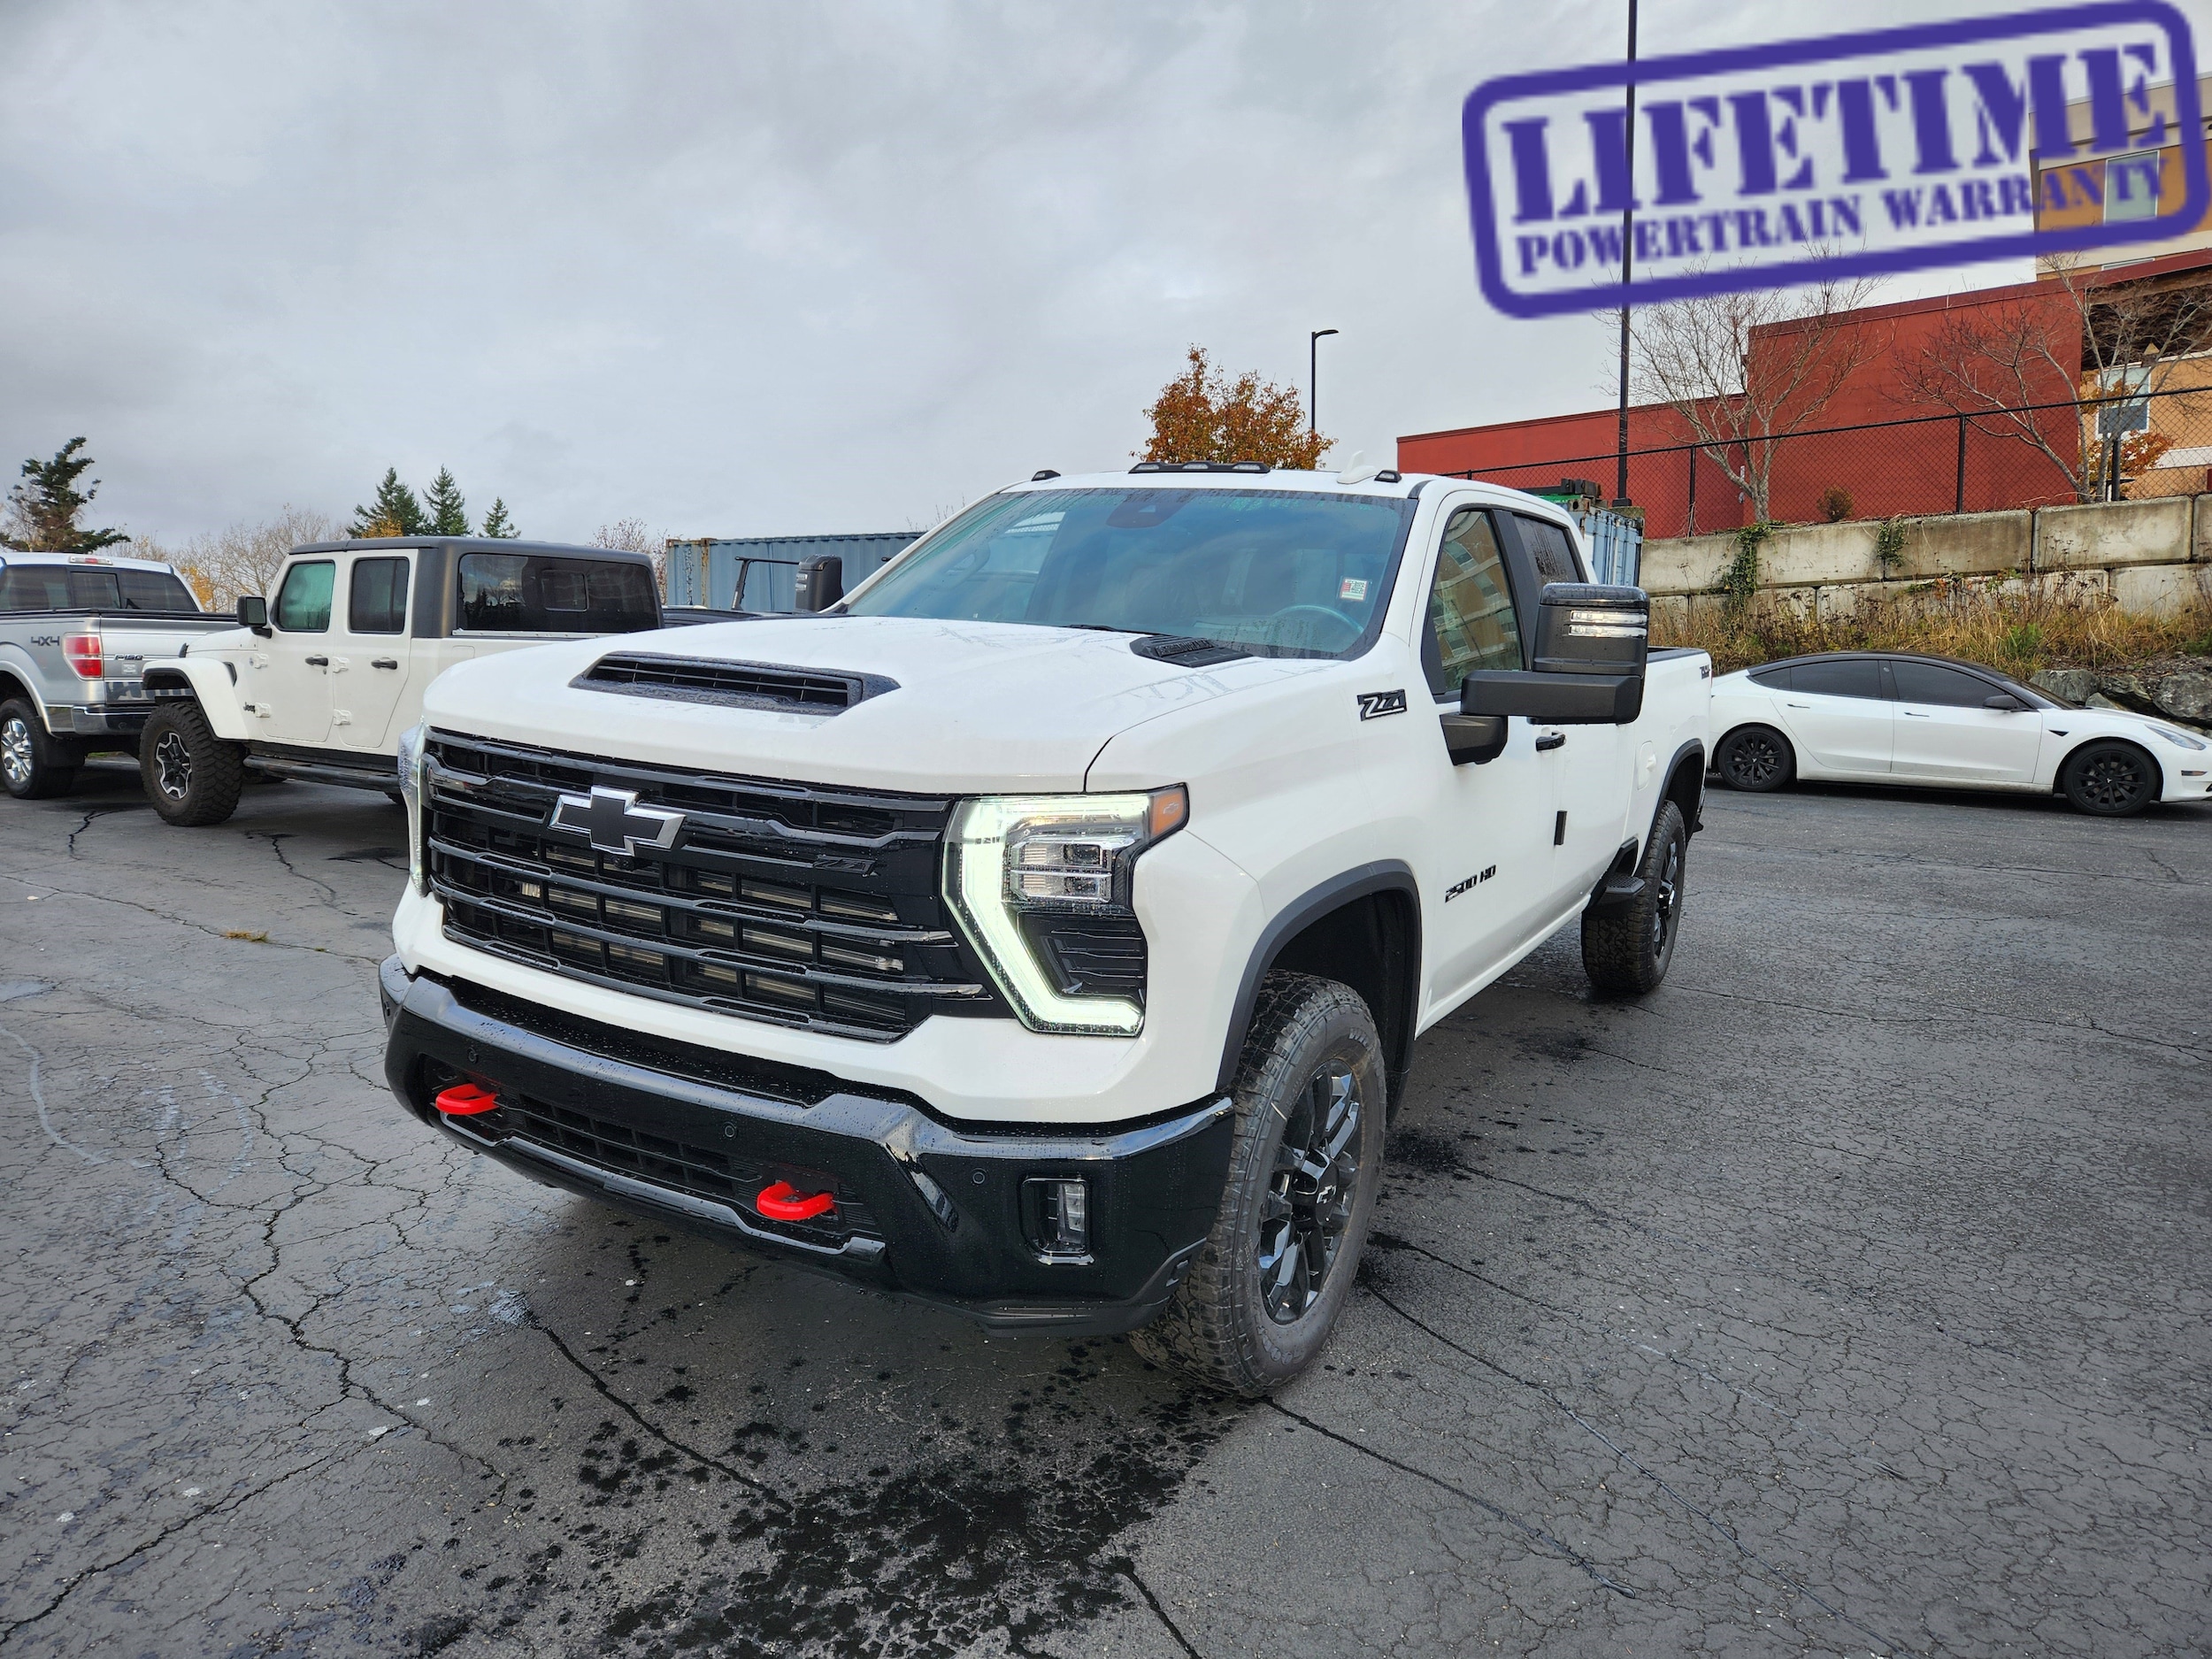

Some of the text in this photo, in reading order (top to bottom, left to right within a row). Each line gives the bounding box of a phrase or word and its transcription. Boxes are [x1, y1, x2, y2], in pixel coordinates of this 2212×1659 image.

[30, 635, 61, 646] 4X4
[1356, 688, 1408, 721] Z71
[1445, 864, 1496, 902] 2500 HD
